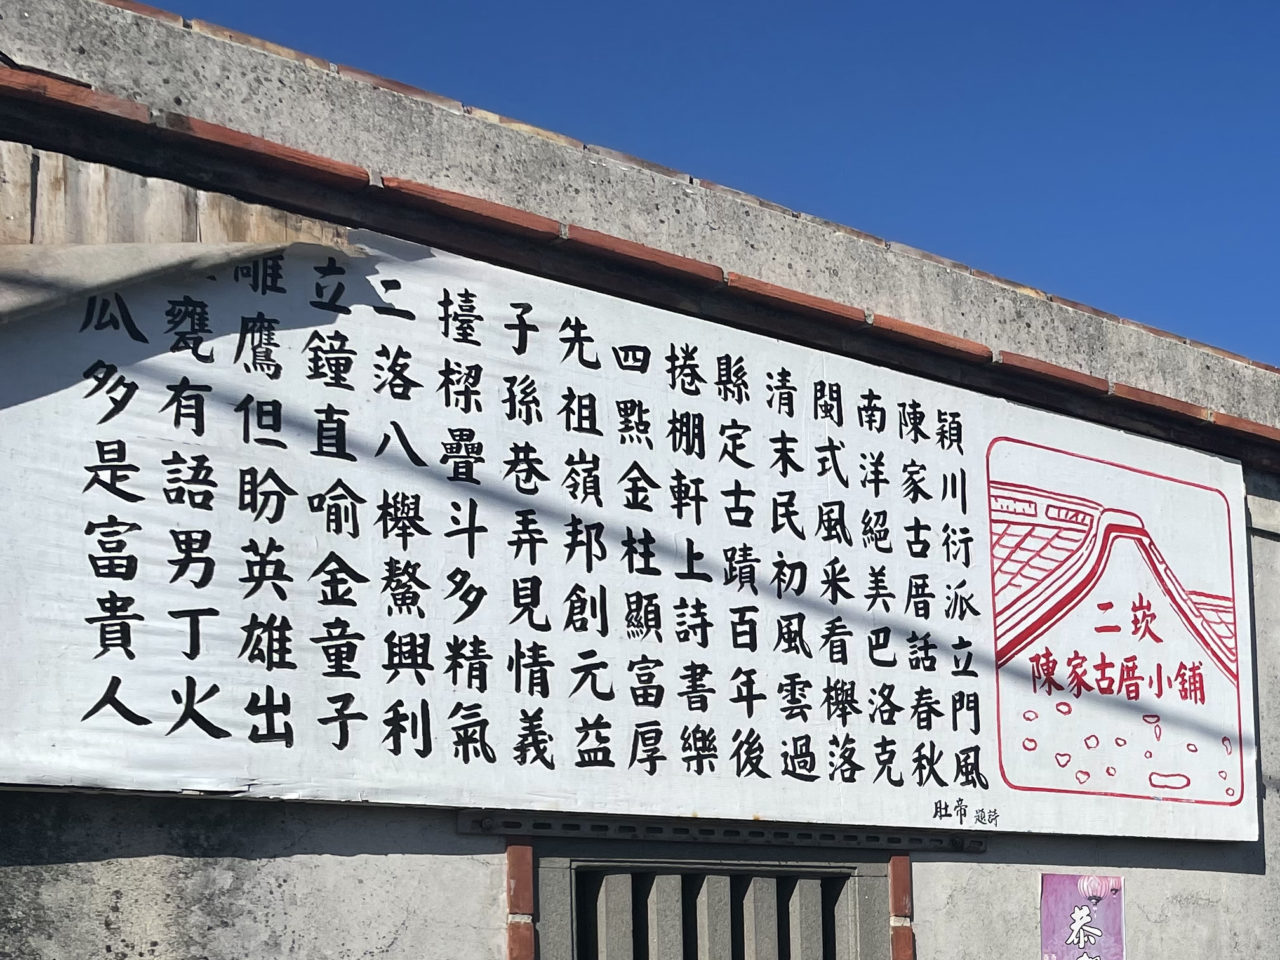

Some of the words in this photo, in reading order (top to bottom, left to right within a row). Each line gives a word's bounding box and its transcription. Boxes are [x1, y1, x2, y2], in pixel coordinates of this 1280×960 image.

[160, 274, 232, 739] 甕有語男丁火
[303, 256, 370, 750] 立鐘直喻金童子
[502, 303, 556, 770] 子孫巷弄見情義
[557, 317, 615, 767] 先祖嶺邦創元益
[612, 345, 666, 775] 四點金柱顯富厚
[665, 343, 718, 775] 捲棚軒上詩書樂
[714, 354, 771, 778] 縣定古蹟百年後
[766, 367, 820, 782] 清末民初風雲過
[858, 389, 904, 787] 南洋絕美巴洛克
[897, 399, 948, 787] 陳家古厝話春秋
[1094, 592, 1164, 643] 二崁
